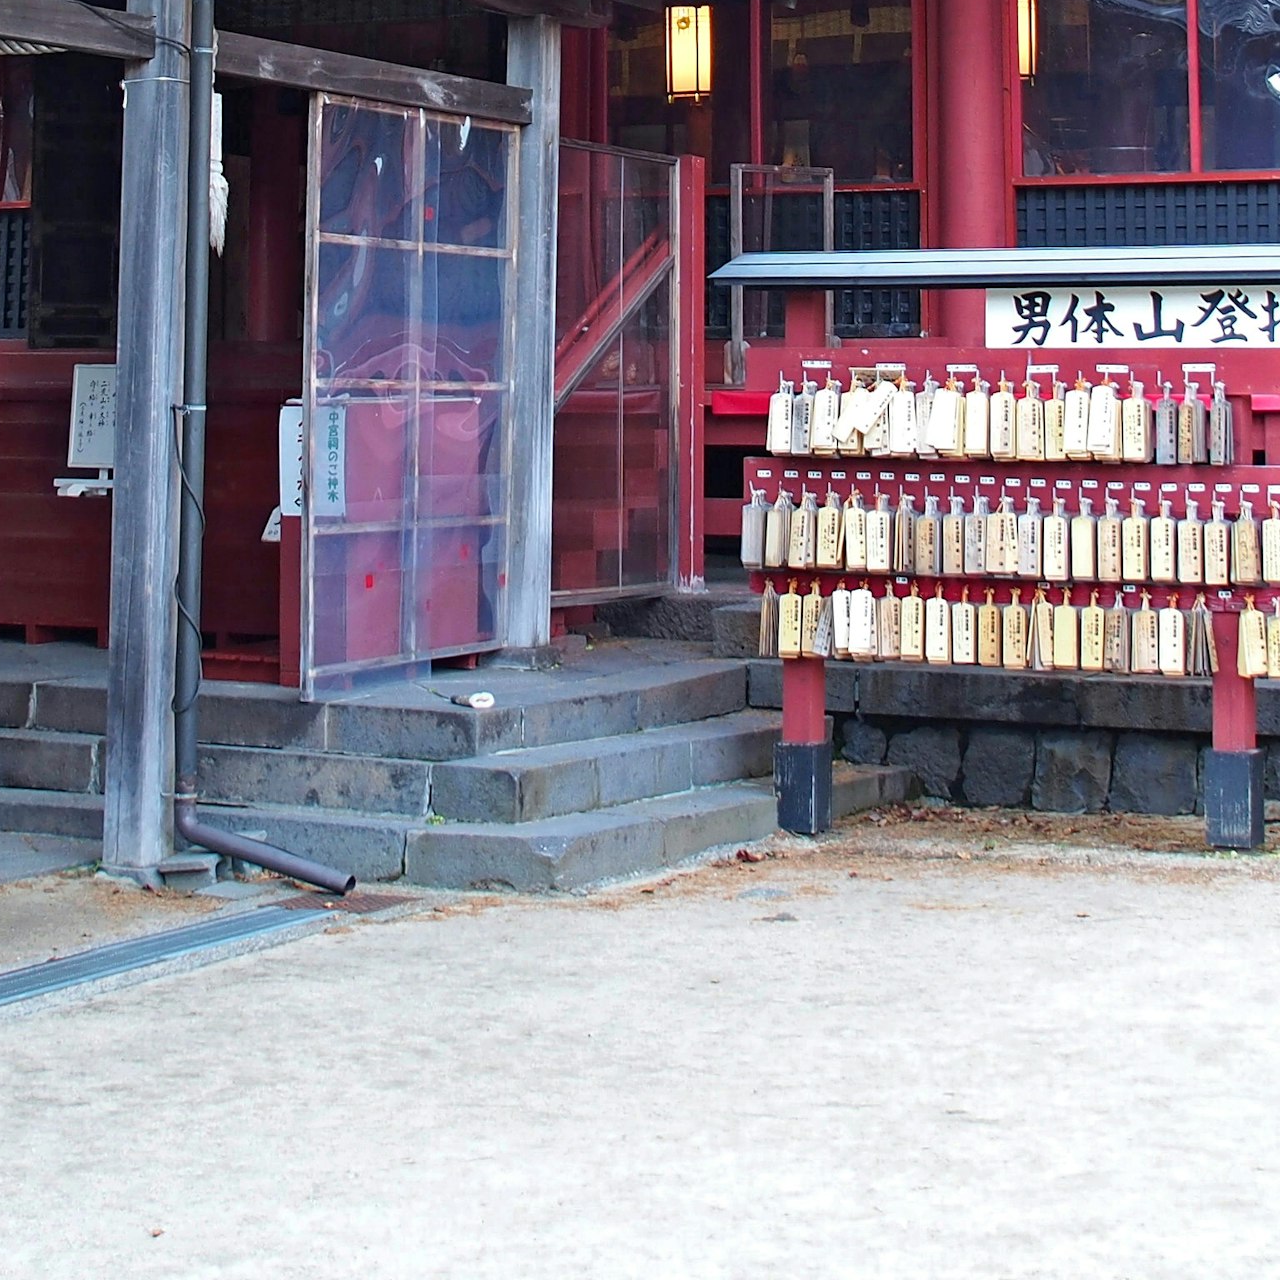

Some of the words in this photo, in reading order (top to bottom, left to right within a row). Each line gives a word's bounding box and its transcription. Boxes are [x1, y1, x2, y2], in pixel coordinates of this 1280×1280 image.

[327, 410, 340, 504] 中宮祠のご神木
